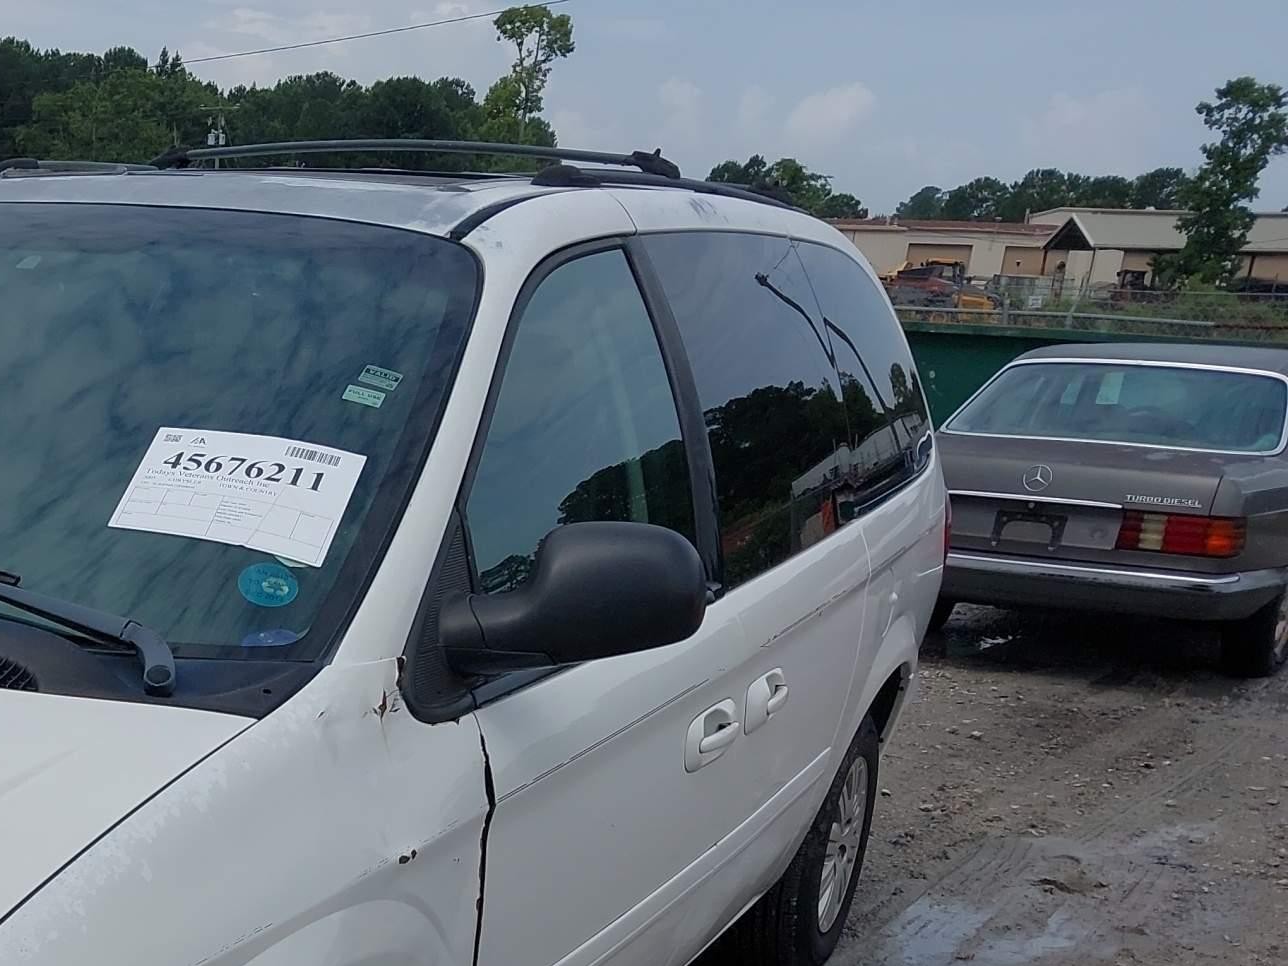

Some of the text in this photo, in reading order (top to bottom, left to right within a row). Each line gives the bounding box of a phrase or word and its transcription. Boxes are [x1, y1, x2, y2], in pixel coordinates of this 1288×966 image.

[163, 451, 324, 493] 45676211
[179, 470, 214, 480] Veterans
[216, 475, 254, 486] Outreach
